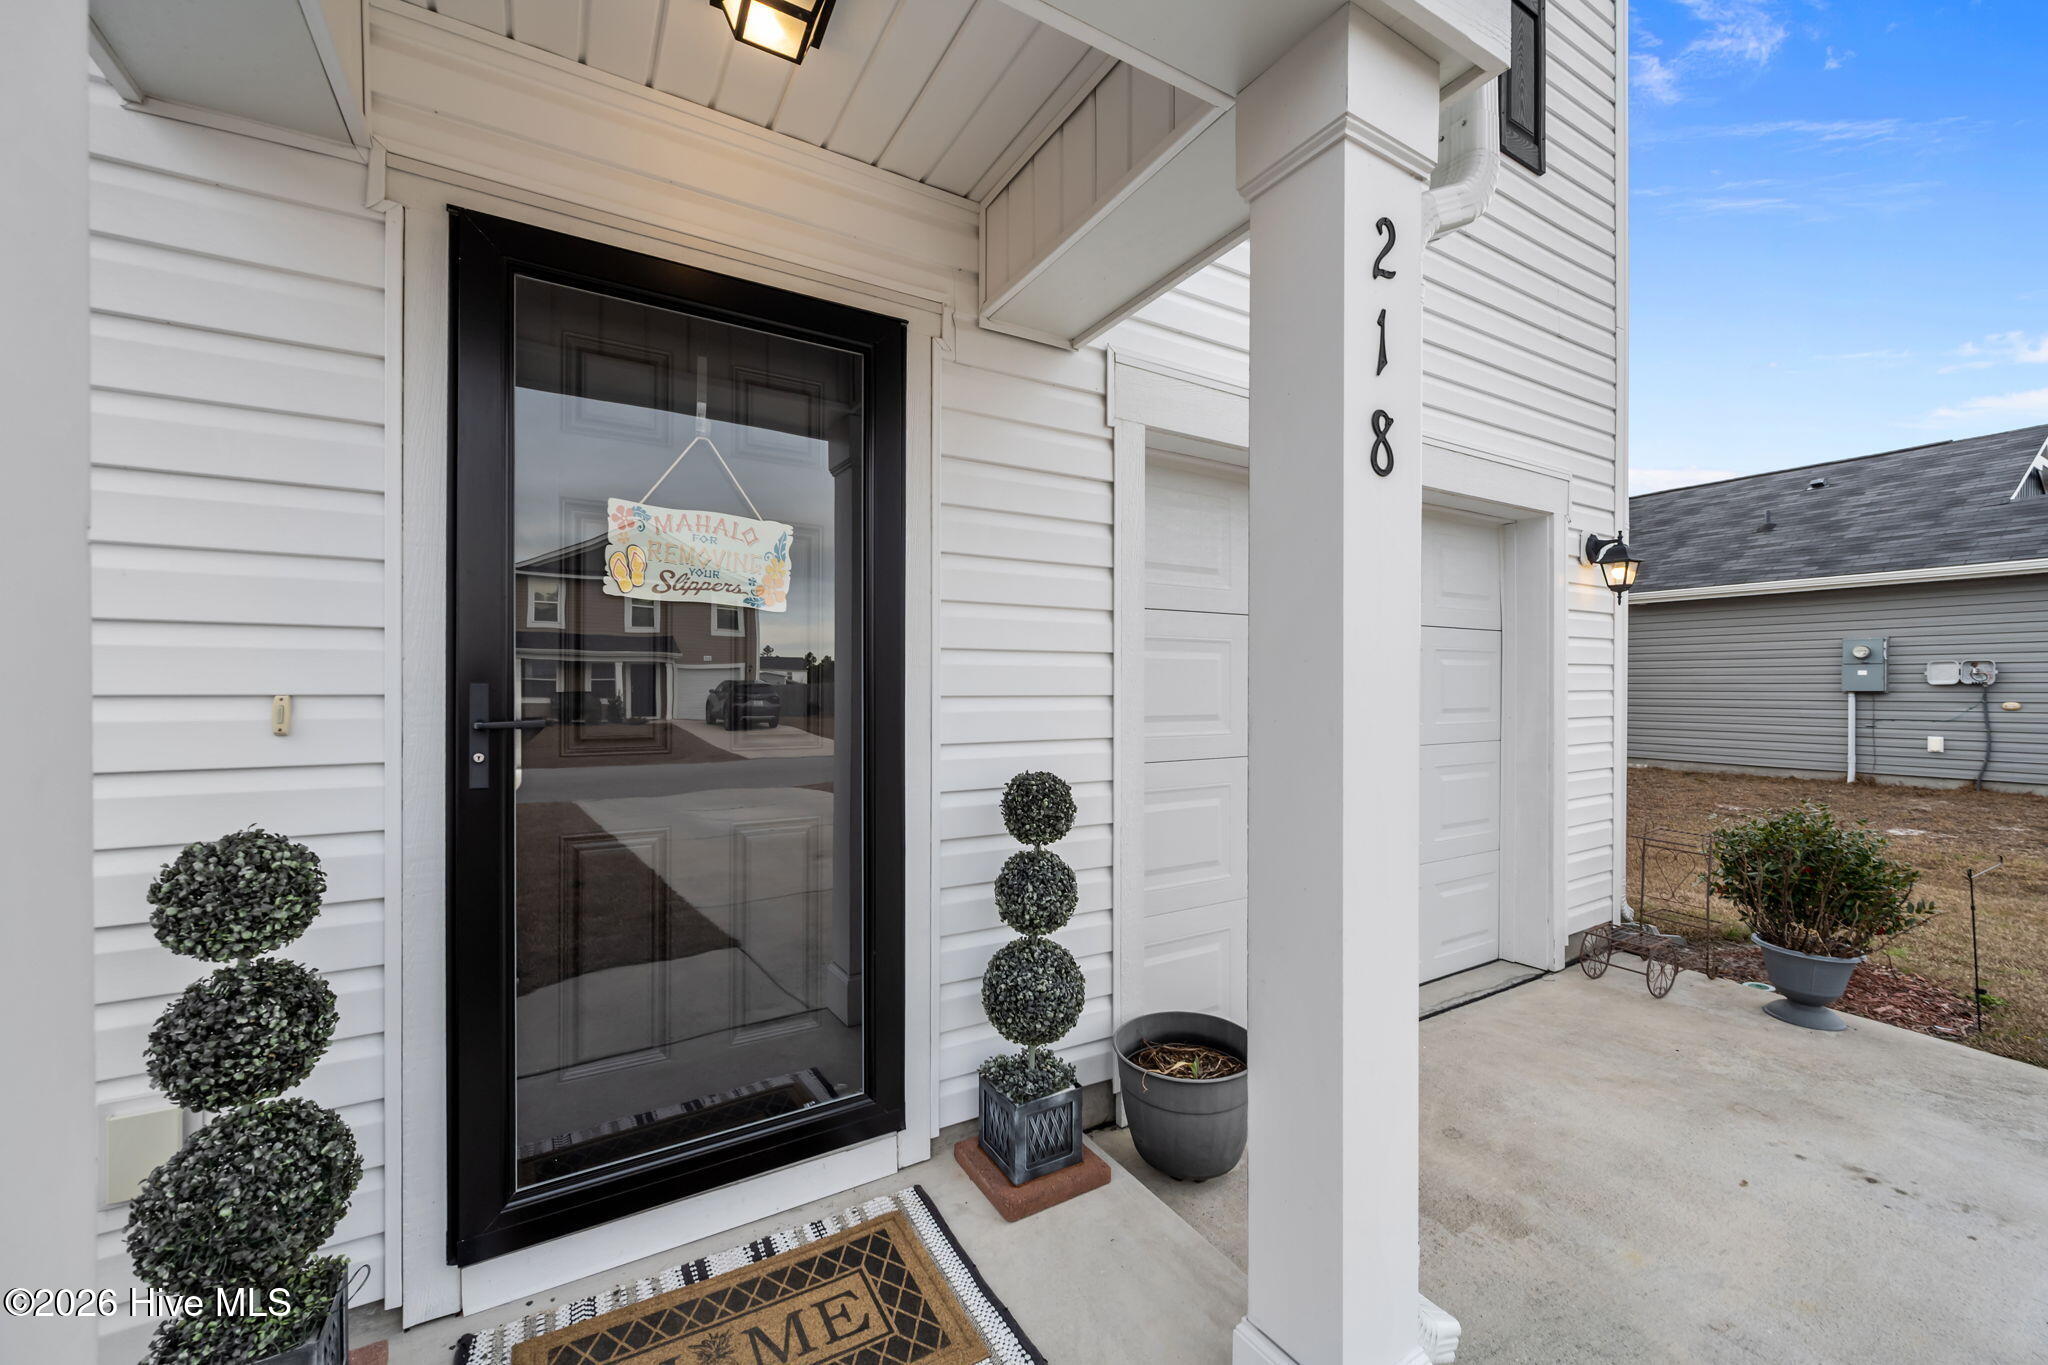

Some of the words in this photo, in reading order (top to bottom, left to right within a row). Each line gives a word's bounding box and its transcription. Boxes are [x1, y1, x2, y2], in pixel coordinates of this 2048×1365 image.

[1371, 216, 1396, 477] 218
[654, 513, 759, 546] MAHALO
[692, 533, 718, 544] FOR
[651, 569, 749, 596] Slippers
[688, 567, 720, 579] YOUR
